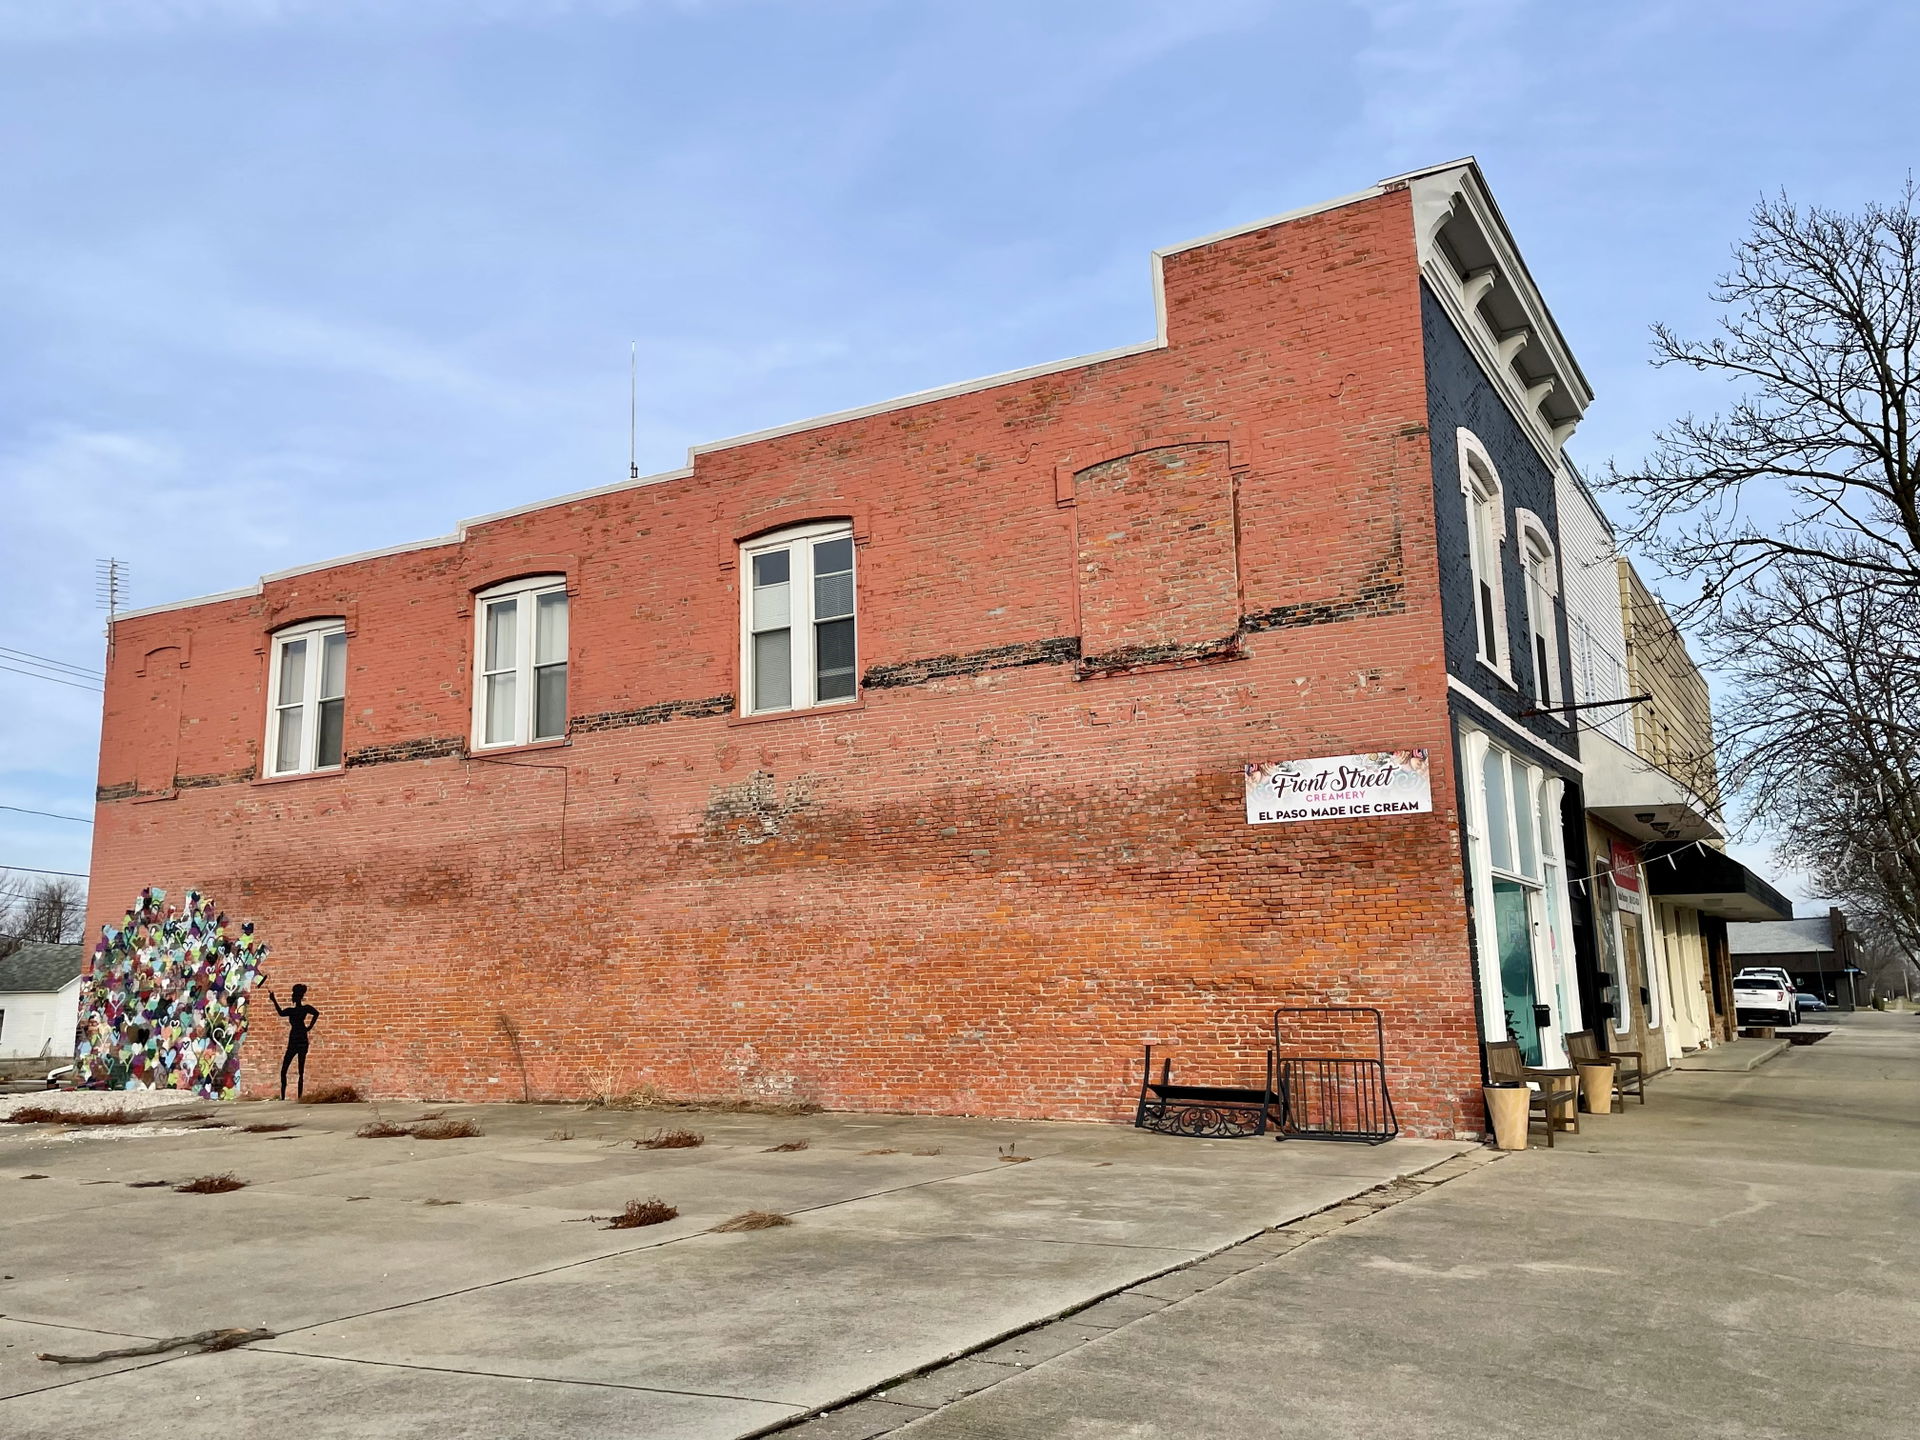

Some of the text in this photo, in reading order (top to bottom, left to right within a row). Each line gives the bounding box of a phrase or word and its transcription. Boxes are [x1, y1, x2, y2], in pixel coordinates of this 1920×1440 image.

[1271, 765, 1400, 798] Front Street
[1305, 790, 1366, 802] CREAMERY
[1259, 802, 1419, 820] EL PASO MADE ICE CREAM
